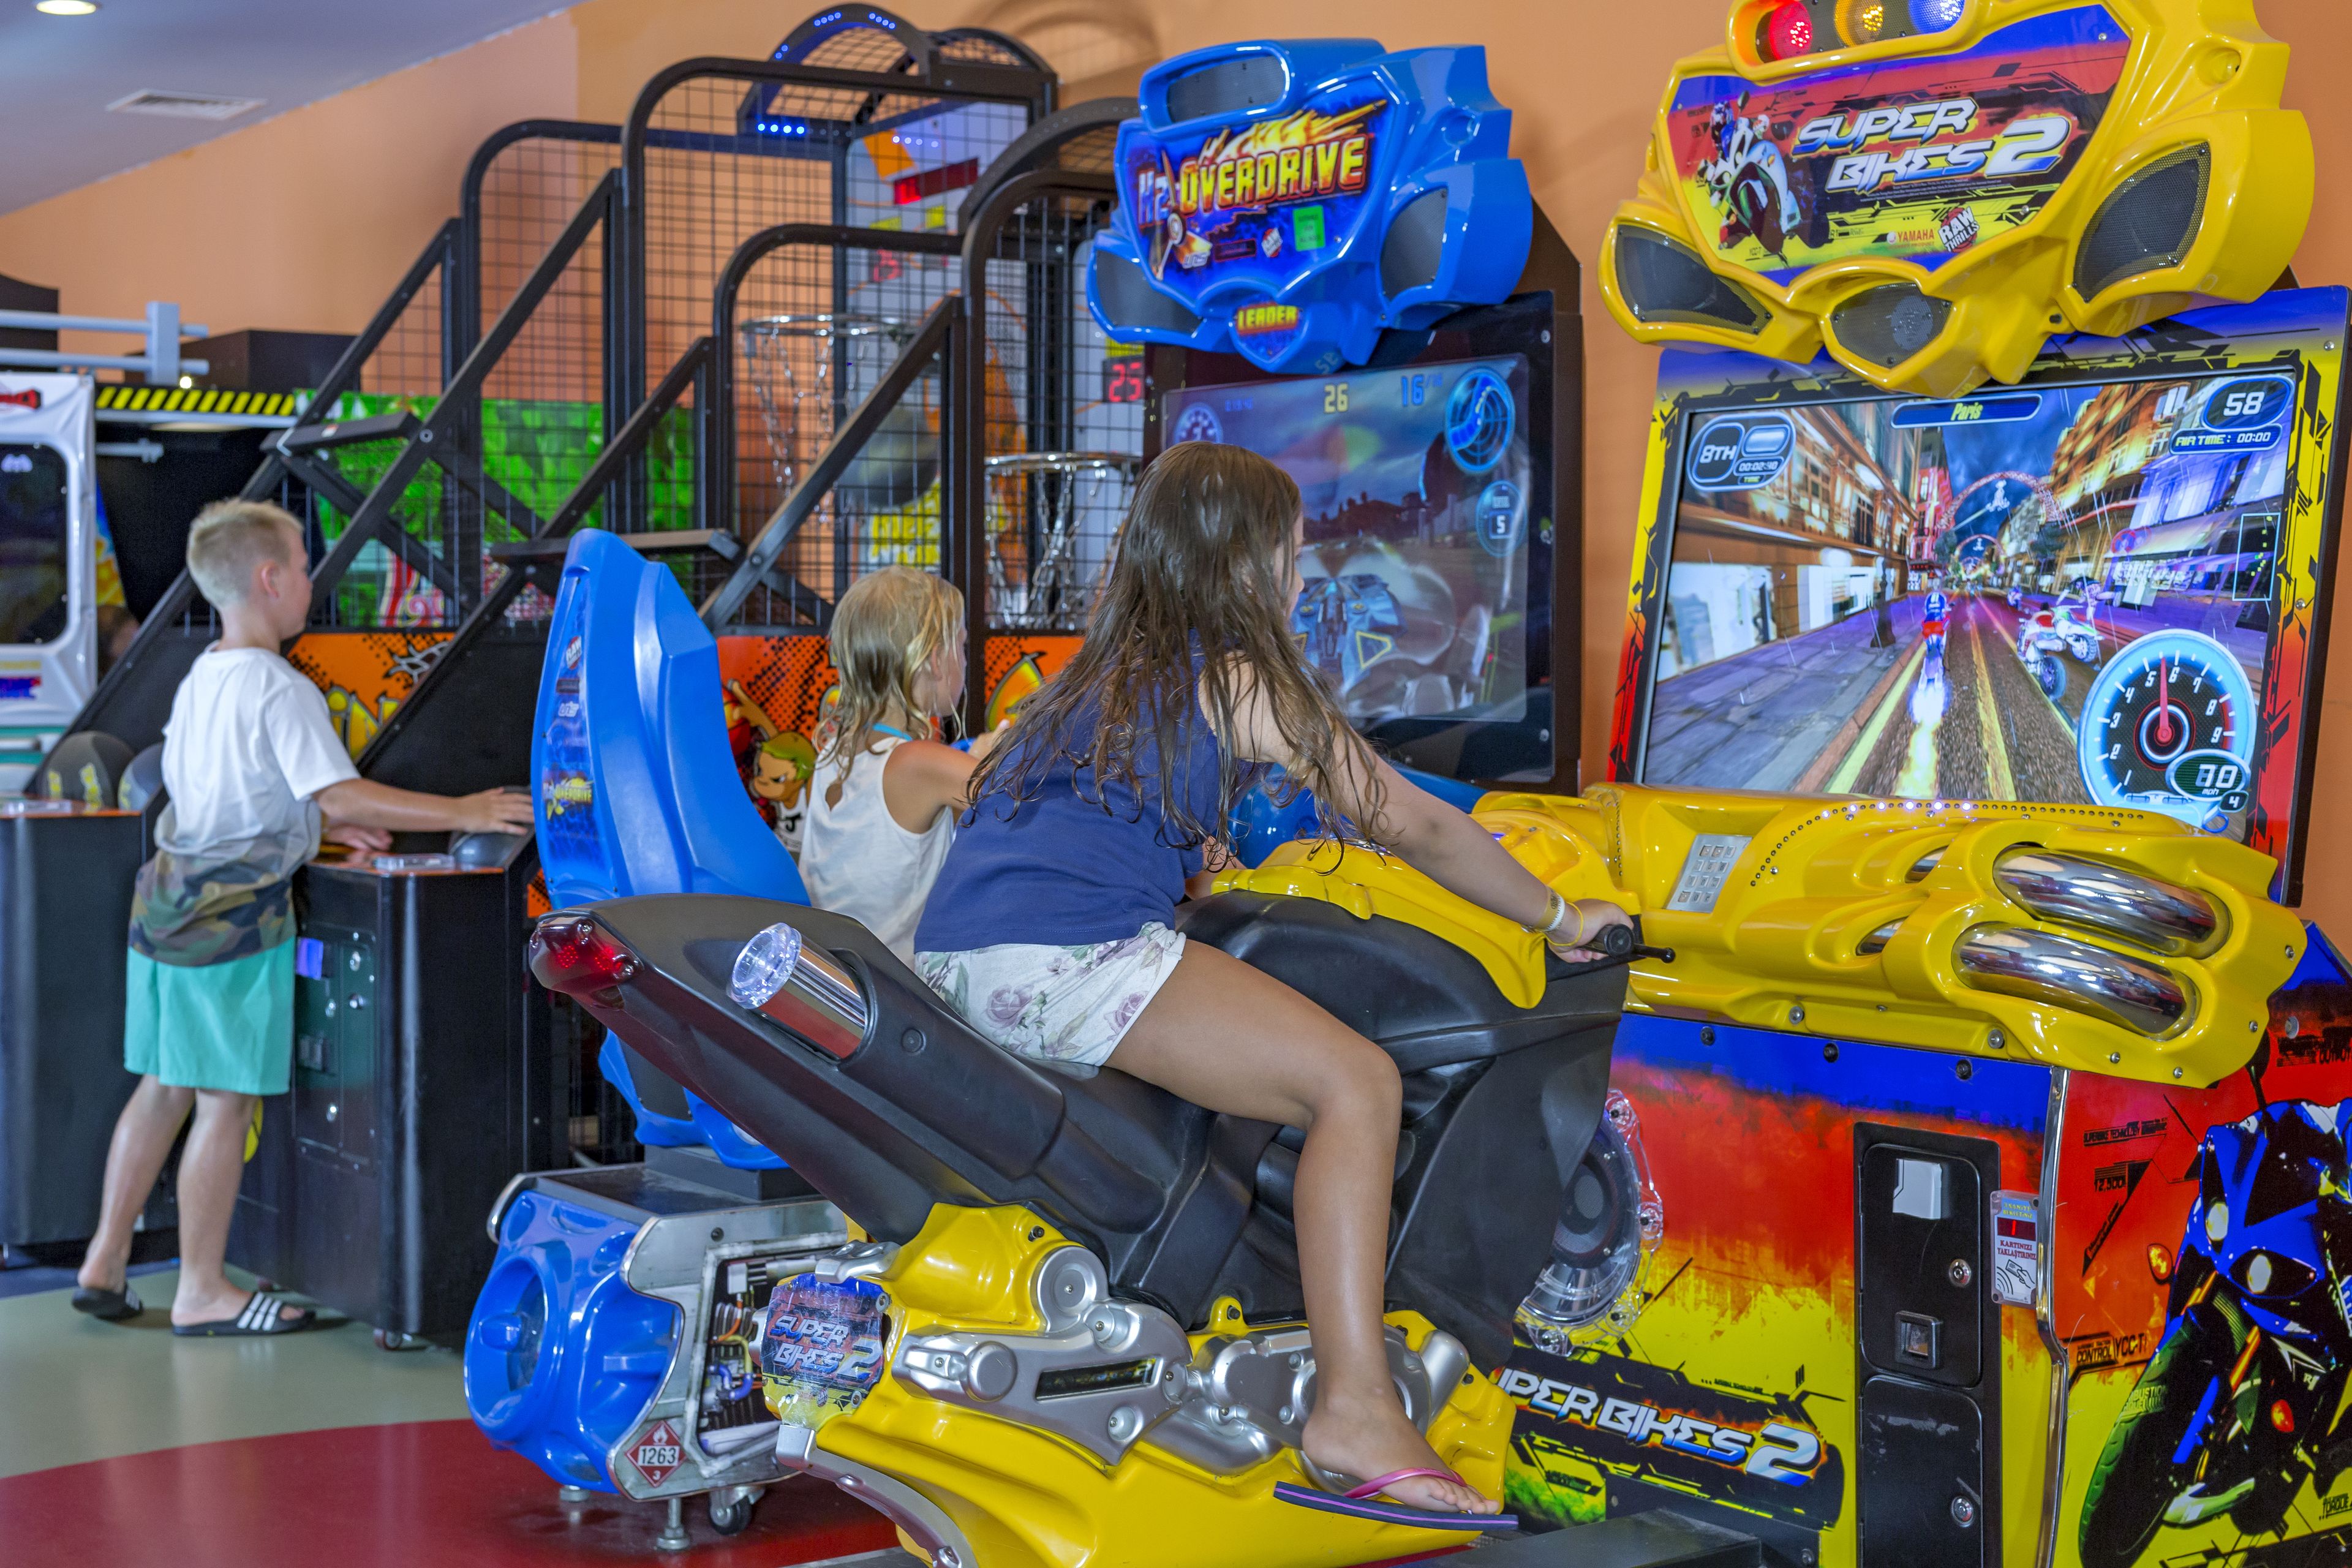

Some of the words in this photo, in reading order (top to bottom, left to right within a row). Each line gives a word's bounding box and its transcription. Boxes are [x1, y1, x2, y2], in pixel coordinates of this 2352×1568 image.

[1792, 98, 1977, 156] SUPER
[1826, 140, 1994, 193] BIKES
[1985, 116, 2070, 176] 2
[1180, 137, 1365, 214] OVERDRIVE
[1939, 206, 1975, 244] RAW
[1898, 228, 1935, 243] YAMAHA
[1945, 221, 1979, 252] THRILLS
[1238, 306, 1298, 331] LEADER
[1324, 383, 1348, 414] 26
[2223, 391, 2265, 417] 58
[1950, 402, 1984, 421] Paris
[2176, 436, 2196, 447] AIR
[2237, 432, 2271, 443] 00:00
[1700, 445, 1737, 464] 8TH
[1496, 515, 1506, 534] 5
[2145, 671, 2157, 687] 5
[2168, 666, 2180, 683] 6
[2193, 676, 2203, 693] 7
[2125, 687, 2135, 703] 4
[2205, 699, 2218, 716] 8
[2110, 712, 2121, 728] 3
[2211, 726, 2223, 743] 9
[2110, 744, 2121, 760] 2
[2228, 796, 2239, 808] 4
[2000, 1240, 2032, 1251] KARTINIZI
[770, 1314, 850, 1349] SUPER
[774, 1343, 845, 1374] BIKES
[837, 1337, 882, 1380] 2
[2076, 1346, 2111, 1363] CONTROL
[1498, 1368, 1599, 1419] PER
[1596, 1397, 1754, 1463] BIKES
[1745, 1423, 1819, 1487] 2
[642, 1448, 676, 1464] 1263
[652, 1470, 661, 1480] 3
